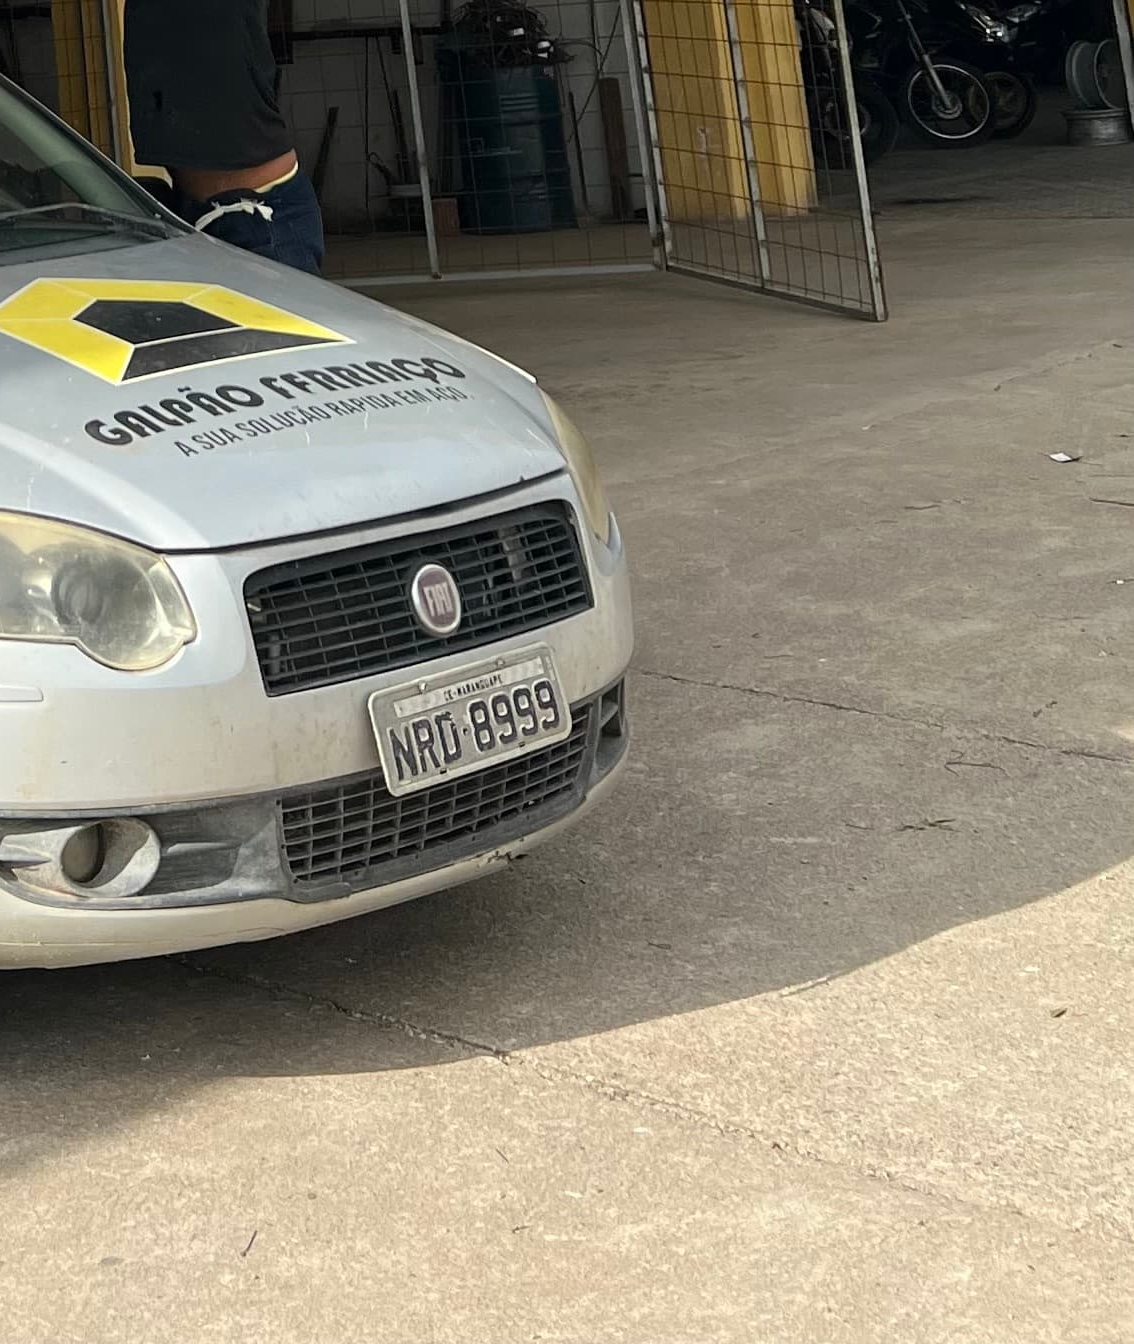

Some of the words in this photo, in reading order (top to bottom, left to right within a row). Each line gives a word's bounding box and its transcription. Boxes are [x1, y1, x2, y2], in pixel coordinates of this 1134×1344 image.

[84, 385, 265, 446] GALPÃO
[174, 440, 199, 457] A
[191, 427, 243, 450] SUA
[393, 389, 422, 404] EM
[423, 582, 454, 617] FIAT
